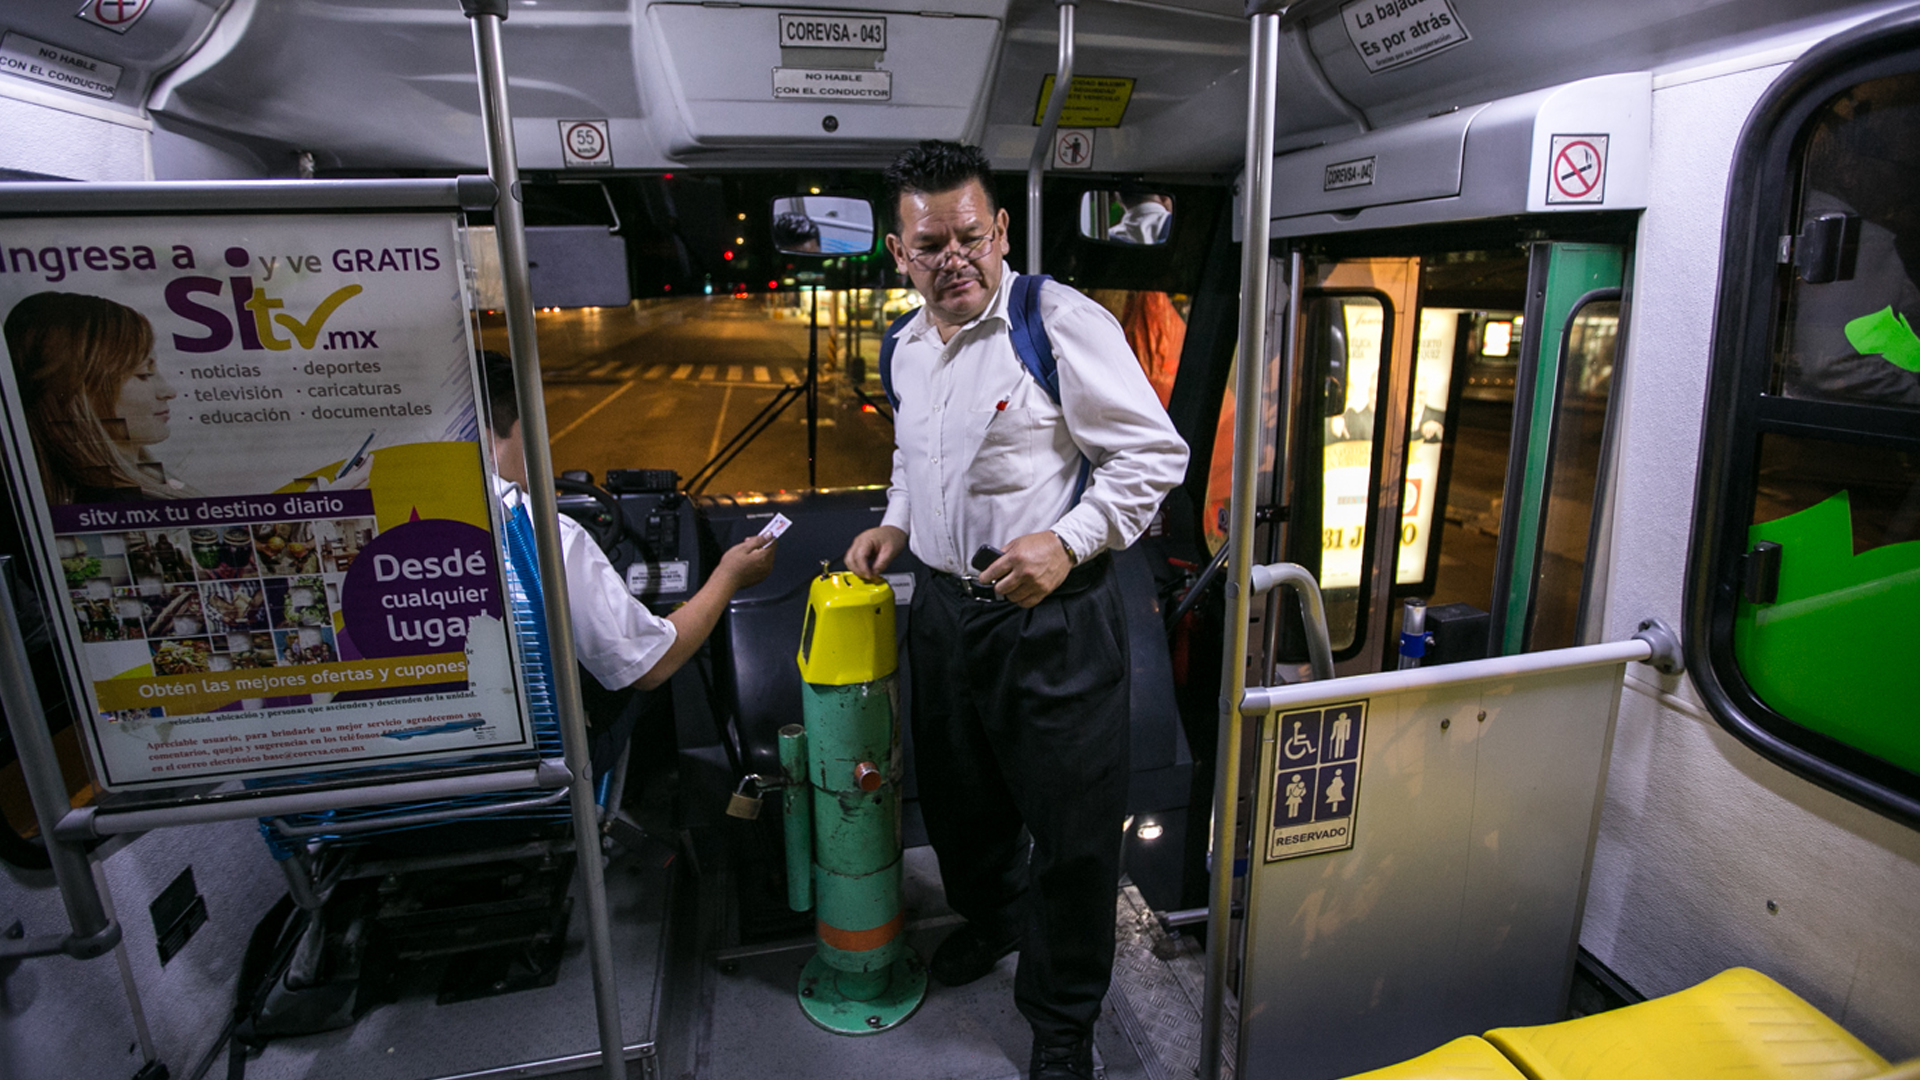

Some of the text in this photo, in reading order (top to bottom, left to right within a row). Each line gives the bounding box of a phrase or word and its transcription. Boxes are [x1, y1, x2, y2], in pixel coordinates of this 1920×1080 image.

[1355, 0, 1426, 29] La baja
[786, 22, 850, 42] COREVSA
[860, 24, 881, 43] 043
[1360, 11, 1451, 57] Es por atrás
[39, 48, 97, 72] NO HABLE
[0, 56, 115, 93] CON EL CONDUCTOR
[805, 73, 862, 82] NO HABLE
[775, 86, 888, 97] CON EL CONDUCTOR
[577, 130, 594, 145] 55
[0, 244, 440, 282] Ingresa a y ve GRATIS
[191, 361, 382, 379] noticias deportes
[194, 383, 402, 402] televisión caricaturas
[200, 402, 432, 425] educación documentales
[79, 496, 344, 527] sitv.mx tu destino diario
[381, 586, 489, 610] cualquier
[138, 660, 467, 699] Obtén las mejores ofertas y cupones
[216, 710, 258, 721] ubicación
[259, 711, 264, 719] y
[267, 708, 306, 718] personas
[307, 706, 324, 715] que
[325, 700, 367, 711] ascienden
[369, 701, 374, 709] y
[377, 696, 423, 707] descienden
[424, 694, 434, 702] de
[436, 693, 445, 701] la
[446, 690, 477, 701] unidad.
[147, 737, 198, 750] Apreciable
[202, 734, 241, 744] usuario,
[245, 731, 268, 742] para
[271, 726, 316, 737] brindarle
[336, 722, 363, 732] mejor
[367, 718, 402, 728] servicio
[406, 712, 464, 725] agradecemos
[148, 748, 211, 761] comentarios,
[212, 745, 243, 757] quejas
[245, 744, 251, 754] y
[254, 739, 308, 752] sugerencias
[324, 735, 337, 744] los
[339, 732, 380, 742] teléfonos
[166, 763, 174, 771] el
[176, 761, 208, 770] correo
[210, 754, 261, 766] electrónico
[1276, 827, 1346, 847] RESERVADO
